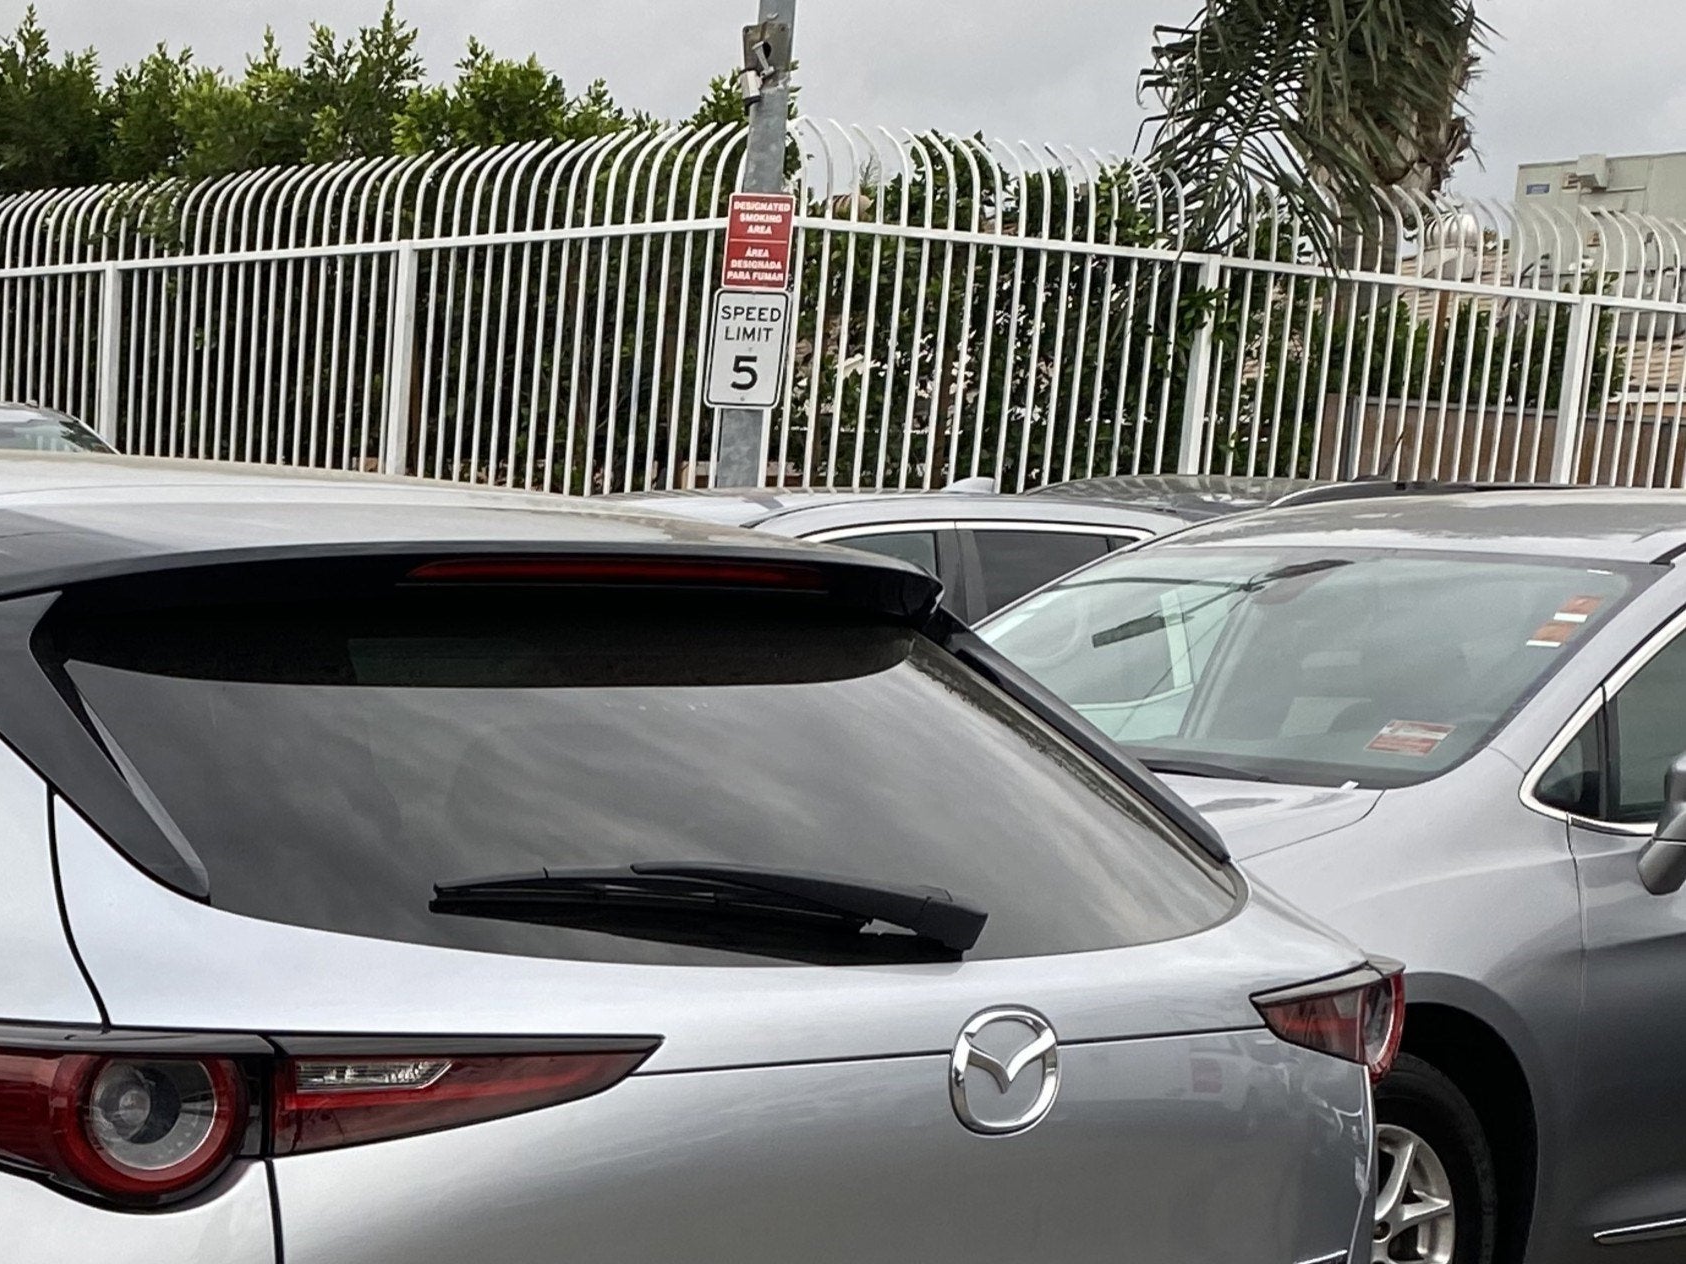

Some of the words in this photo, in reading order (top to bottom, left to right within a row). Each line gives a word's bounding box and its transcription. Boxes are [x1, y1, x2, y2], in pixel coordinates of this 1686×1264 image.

[734, 200, 791, 212] DESIGNATED
[739, 212, 783, 224] SMOKING
[746, 224, 773, 235] AREA
[730, 258, 783, 270] DESIGNADA
[726, 270, 751, 281] PARA
[751, 271, 784, 282] FUMAR
[720, 305, 782, 323] SPEED
[724, 326, 774, 343] LIMIT
[729, 354, 759, 391] 5
